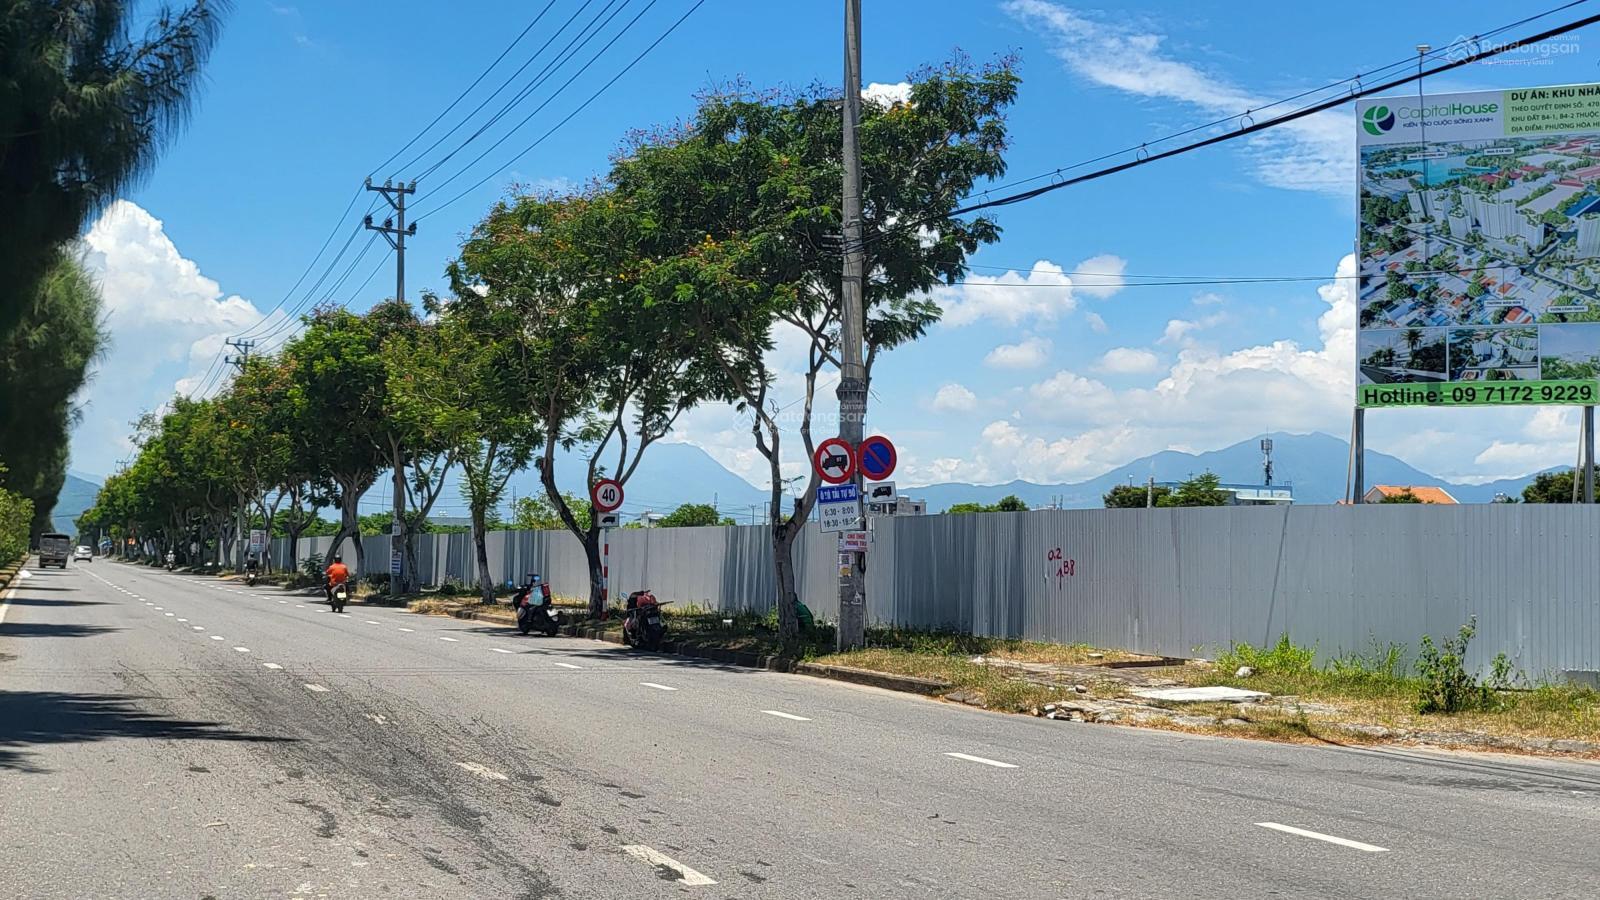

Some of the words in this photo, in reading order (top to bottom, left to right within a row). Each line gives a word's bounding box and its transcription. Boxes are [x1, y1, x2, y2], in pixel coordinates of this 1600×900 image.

[1511, 91, 1527, 102] DỰ
[1530, 89, 1549, 100] ÁN:
[1552, 88, 1575, 98] KHU
[1397, 103, 1499, 119] CapitalHouse
[1530, 103, 1552, 111] QUYẾT
[1433, 119, 1452, 127] CUỘC
[1527, 114, 1540, 122] ĐẤT
[1364, 387, 1444, 404] Hotline:
[1452, 387, 1476, 403] 09
[1483, 386, 1533, 402] 7172
[1541, 384, 1592, 401] 9229
[602, 489, 615, 502] 40
